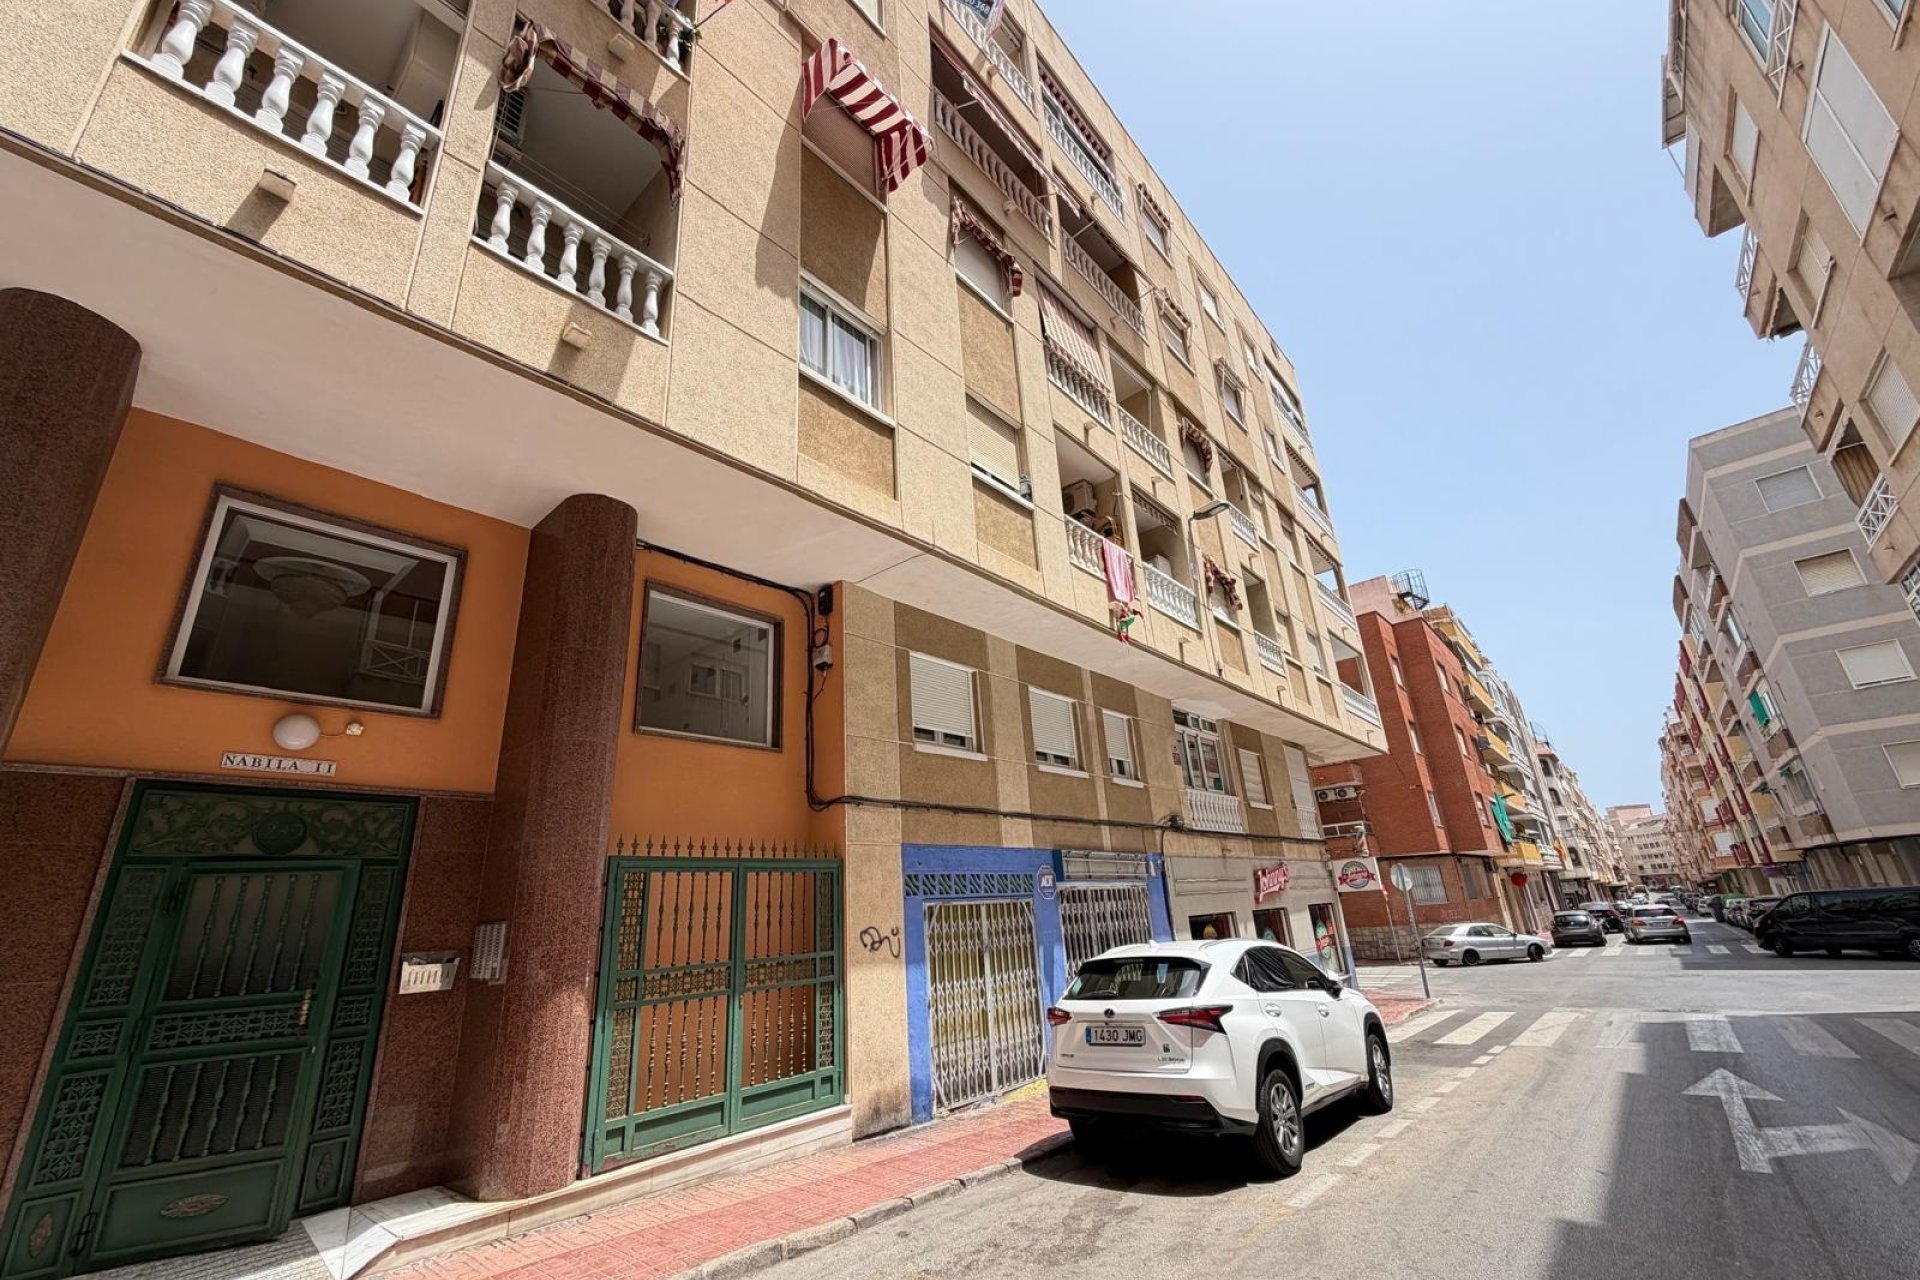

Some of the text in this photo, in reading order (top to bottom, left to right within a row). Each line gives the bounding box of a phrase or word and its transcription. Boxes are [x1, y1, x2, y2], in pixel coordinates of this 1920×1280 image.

[223, 754, 332, 773] NABILA II
[1094, 1029, 1143, 1042] 1430 JMG
